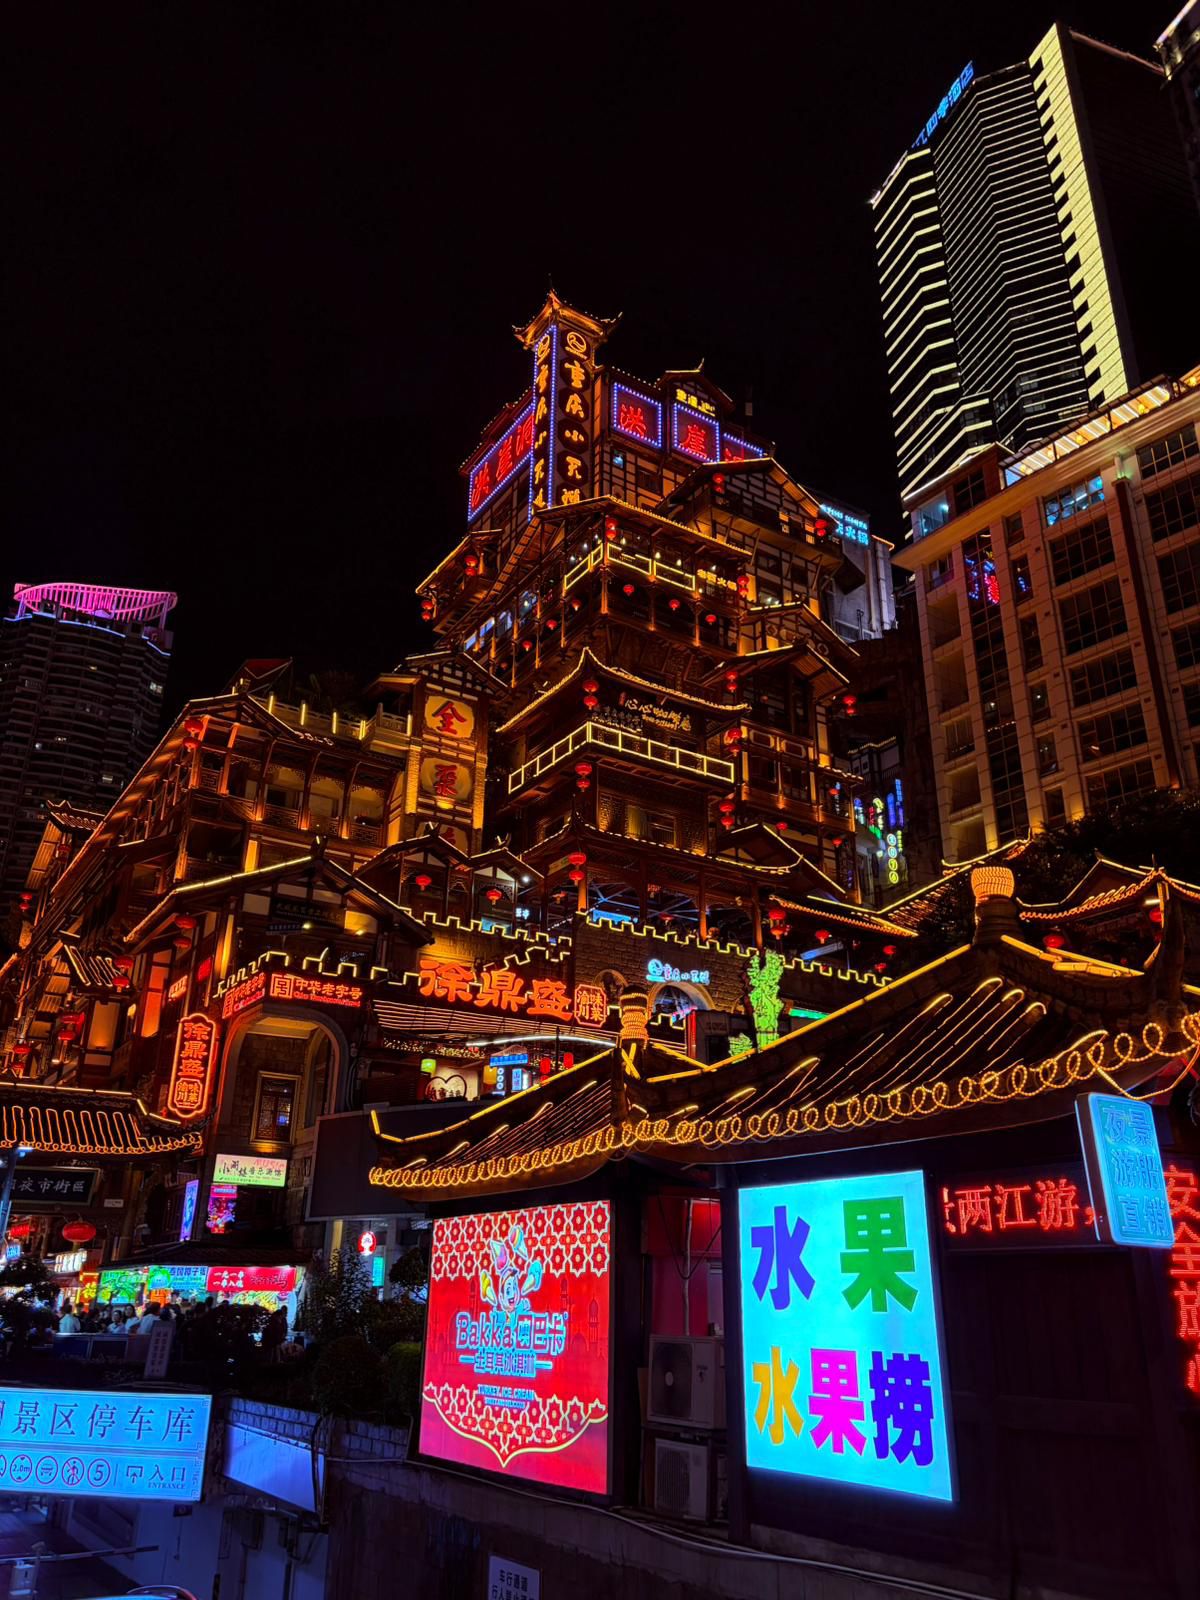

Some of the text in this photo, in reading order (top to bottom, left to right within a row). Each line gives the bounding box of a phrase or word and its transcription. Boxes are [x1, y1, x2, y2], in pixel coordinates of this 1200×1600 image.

[295, 979, 363, 1000] 中华老字号
[419, 959, 573, 1022] 徐鼎盛
[177, 1022, 211, 1078] 徐鼎盛
[1102, 1106, 1153, 1147] 夜景
[750, 1195, 919, 1313] 水果
[456, 1311, 513, 1349] Bakka
[0, 1399, 196, 1443] 景区停车库
[752, 1345, 934, 1467] 水果捞
[93, 1464, 105, 1482] 5
[147, 1481, 186, 1491] ENTRANCE
[148, 1464, 186, 1482] 入口
